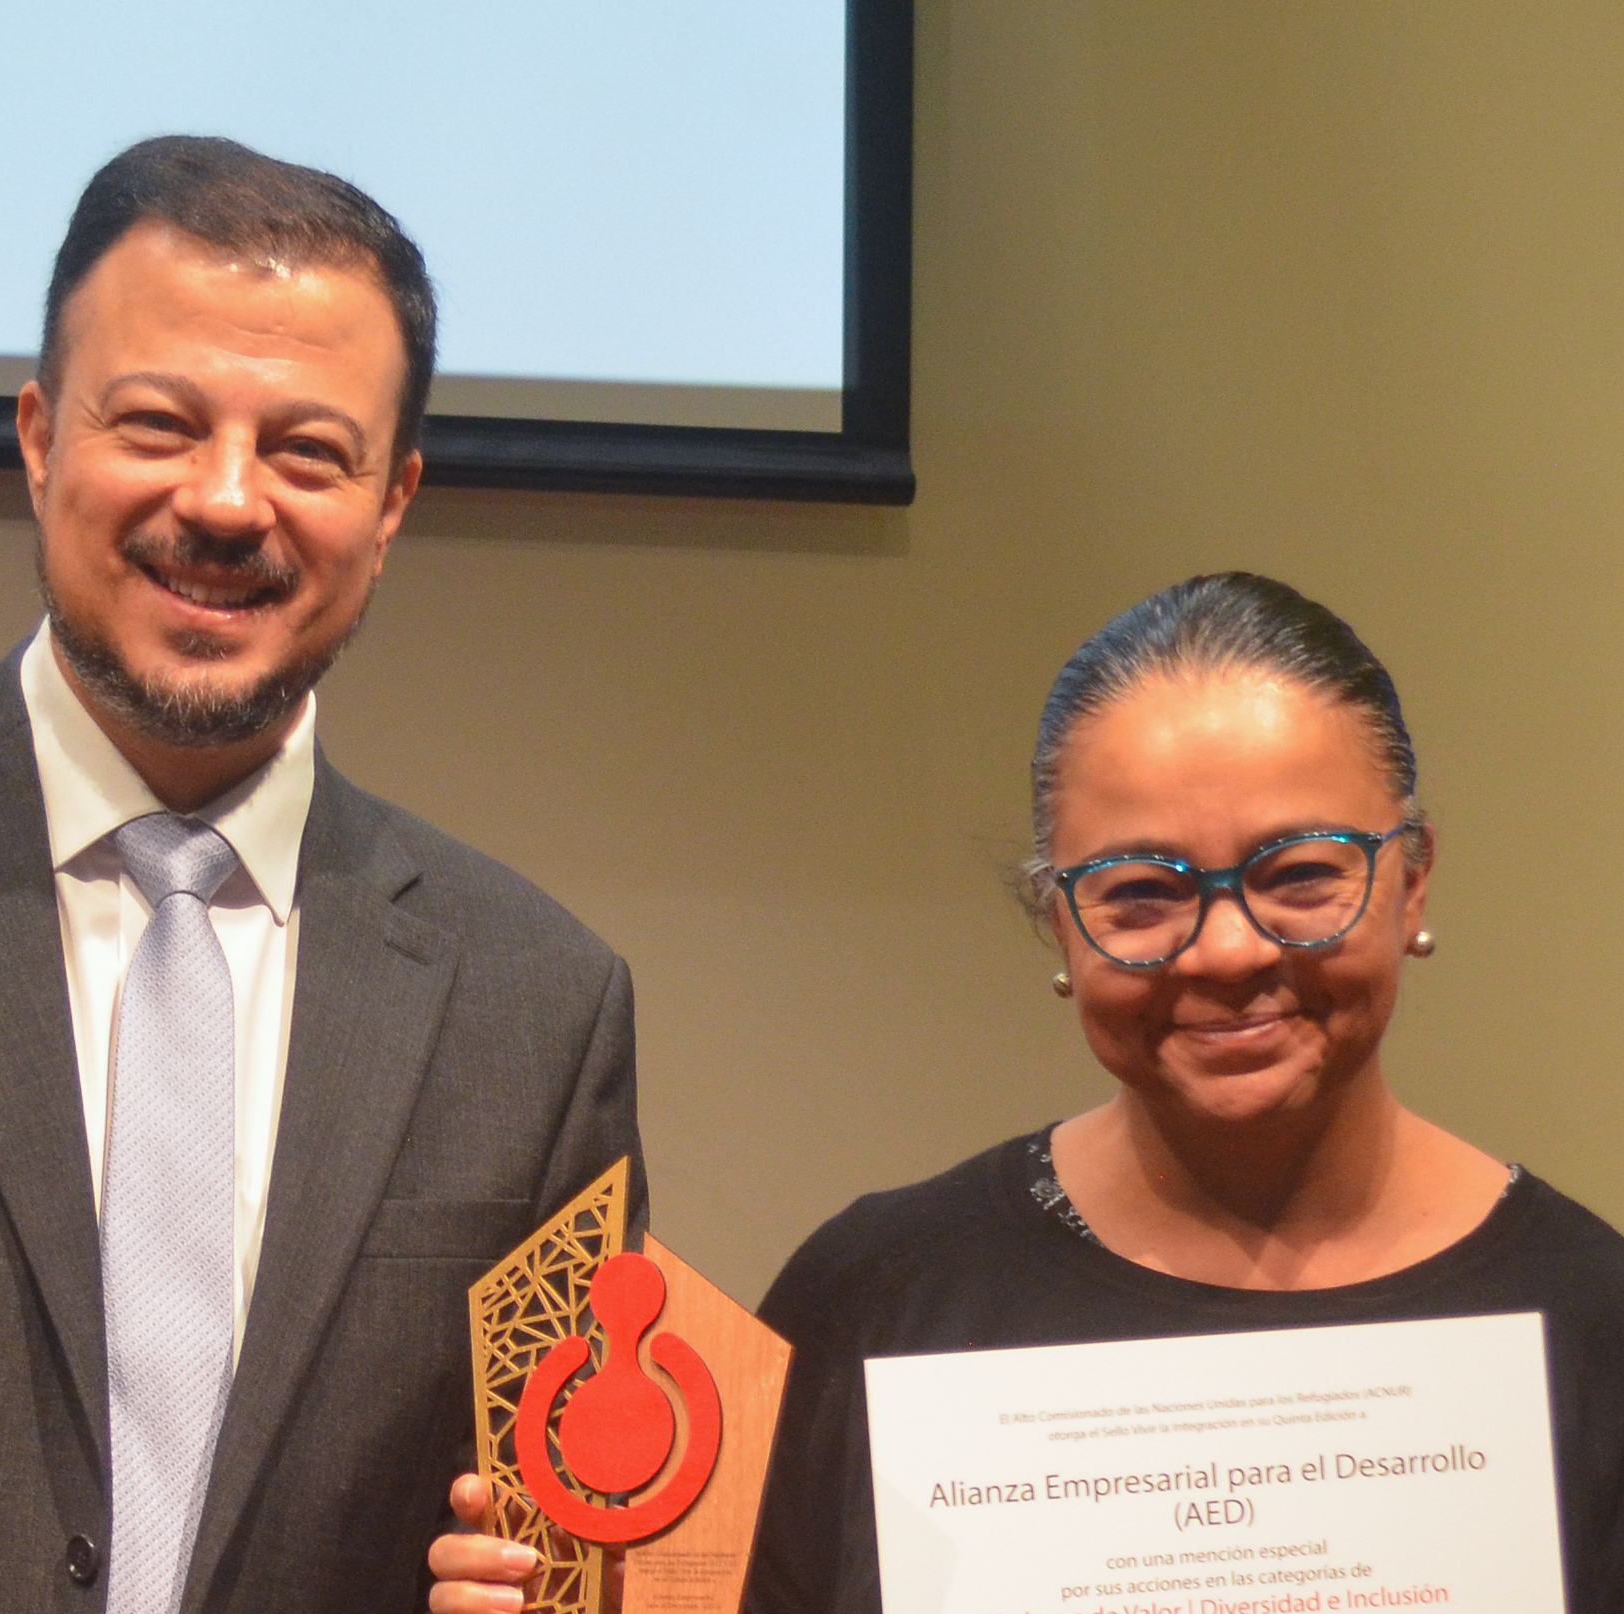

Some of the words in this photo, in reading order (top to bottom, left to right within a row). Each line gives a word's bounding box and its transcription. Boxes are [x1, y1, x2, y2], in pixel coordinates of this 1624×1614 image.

[1037, 1406, 1114, 1422] Comisionado
[1116, 1405, 1132, 1416] de
[1134, 1403, 1149, 1415] las
[1152, 1401, 1205, 1414] Naciones
[1206, 1397, 1246, 1410] Unidas
[1249, 1397, 1274, 1409] para
[1295, 1390, 1360, 1405] Refugiados
[1048, 1431, 1086, 1442] otorga
[1102, 1426, 1129, 1438] Sello
[1240, 1417, 1254, 1427] en
[1272, 1412, 1312, 1426] Quinta
[930, 1480, 1036, 1507] Alianza
[1045, 1462, 1218, 1503] Empresarial
[1229, 1464, 1292, 1493] para
[1301, 1454, 1326, 1482] el
[1335, 1444, 1487, 1480] Desarrollo
[1174, 1497, 1255, 1532] (AED)
[1106, 1555, 1138, 1570] con
[1142, 1553, 1174, 1567] una
[1179, 1546, 1255, 1564] mención
[1259, 1539, 1329, 1563] especial
[1061, 1585, 1090, 1602] por
[1096, 1581, 1122, 1596] sus
[1127, 1576, 1201, 1594] acciones
[1205, 1574, 1226, 1588] en
[1231, 1570, 1254, 1586] las
[1351, 1562, 1373, 1578] de
[1327, 1595, 1341, 1610] e
[1347, 1583, 1450, 1609] Inclusión
